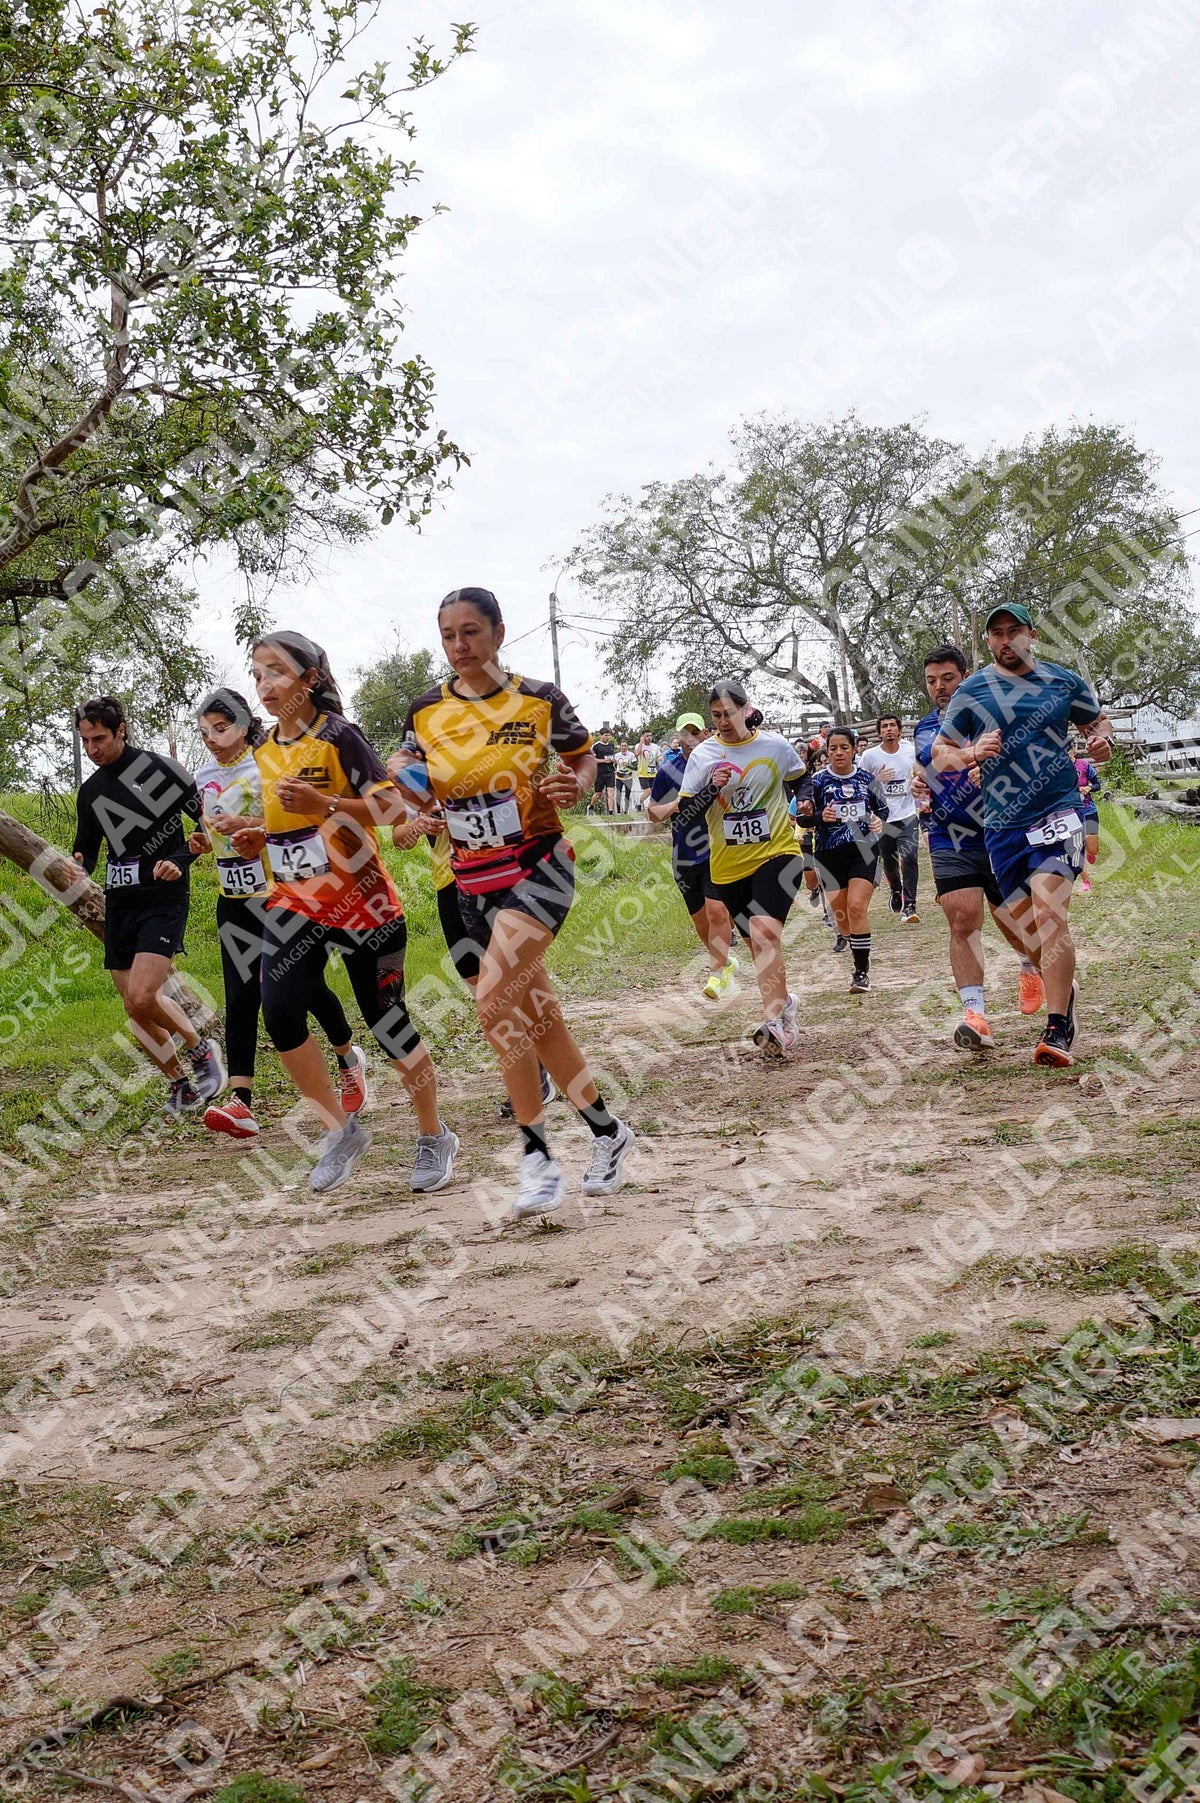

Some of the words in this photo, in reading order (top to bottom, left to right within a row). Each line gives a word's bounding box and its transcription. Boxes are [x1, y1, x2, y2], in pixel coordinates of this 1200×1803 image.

[886, 784, 905, 794] 428
[840, 805, 858, 817] 98
[465, 810, 498, 839] 31
[732, 819, 763, 838] 418
[1042, 818, 1069, 841] 55
[282, 845, 311, 870] 42
[111, 867, 132, 885] 215
[226, 866, 256, 887] 415
